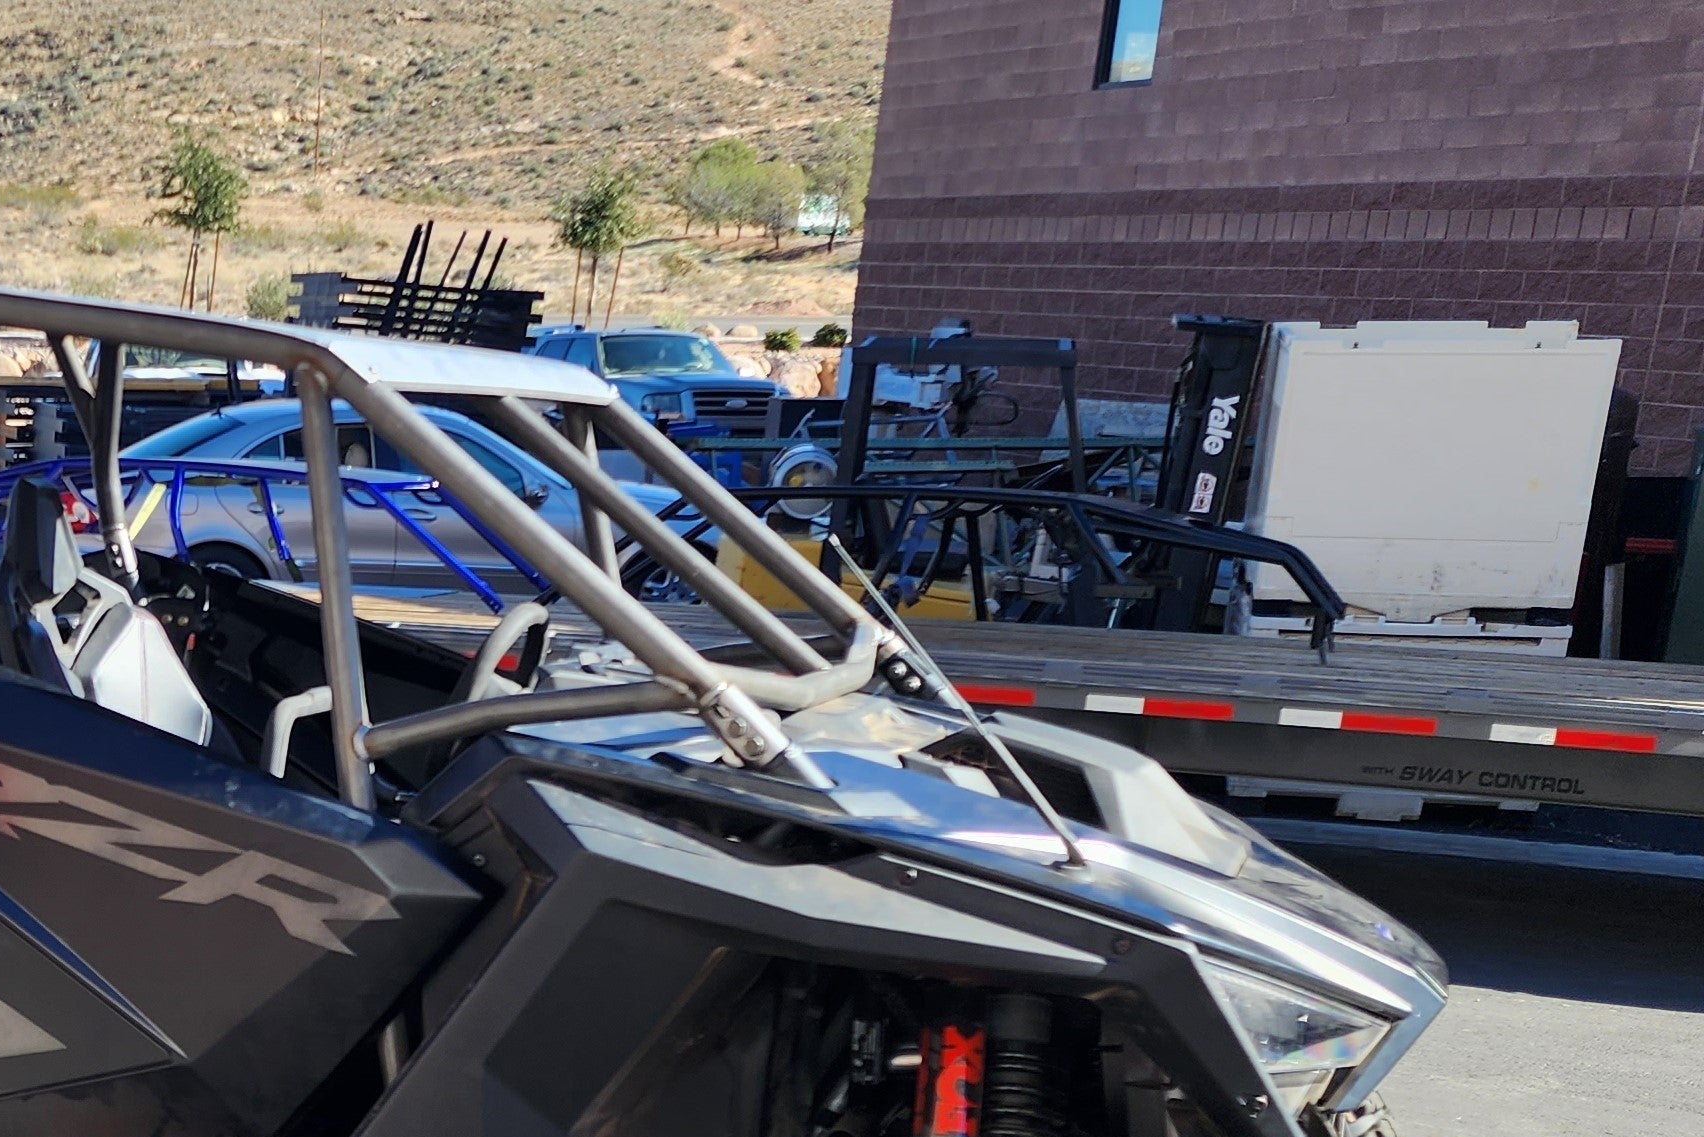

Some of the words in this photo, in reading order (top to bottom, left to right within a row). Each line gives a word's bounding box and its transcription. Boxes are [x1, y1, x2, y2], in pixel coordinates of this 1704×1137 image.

[1203, 395, 1240, 455] Yale
[1399, 765, 1471, 785] SWAY
[1478, 771, 1585, 795] CONTROL
